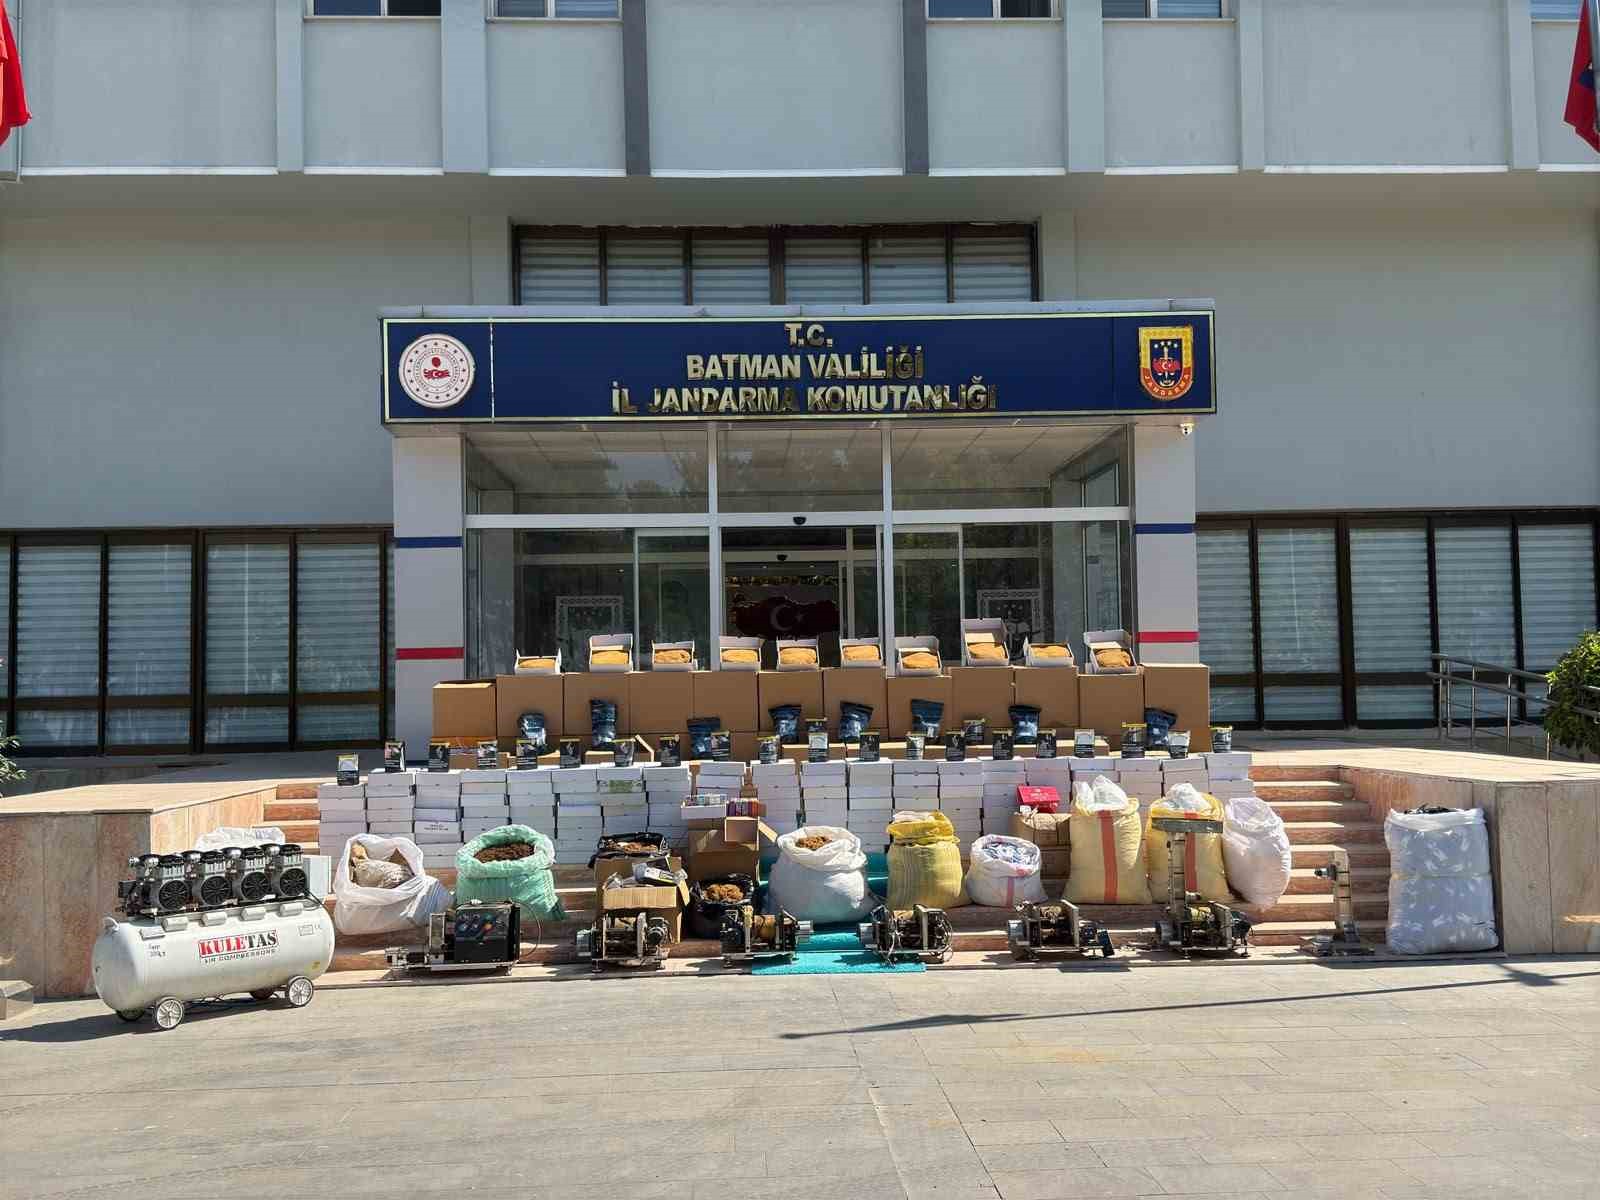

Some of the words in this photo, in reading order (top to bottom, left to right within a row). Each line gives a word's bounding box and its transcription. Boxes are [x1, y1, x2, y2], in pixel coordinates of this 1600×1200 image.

[785, 322, 833, 347] T.C.
[686, 354, 801, 380] BATMAN
[807, 345, 924, 379] VALİLİĞİ
[611, 380, 638, 414] İL
[648, 386, 798, 414] JANDARMA
[807, 375, 997, 412] KOMUTANLIĞI
[200, 931, 277, 956] KULETAS
